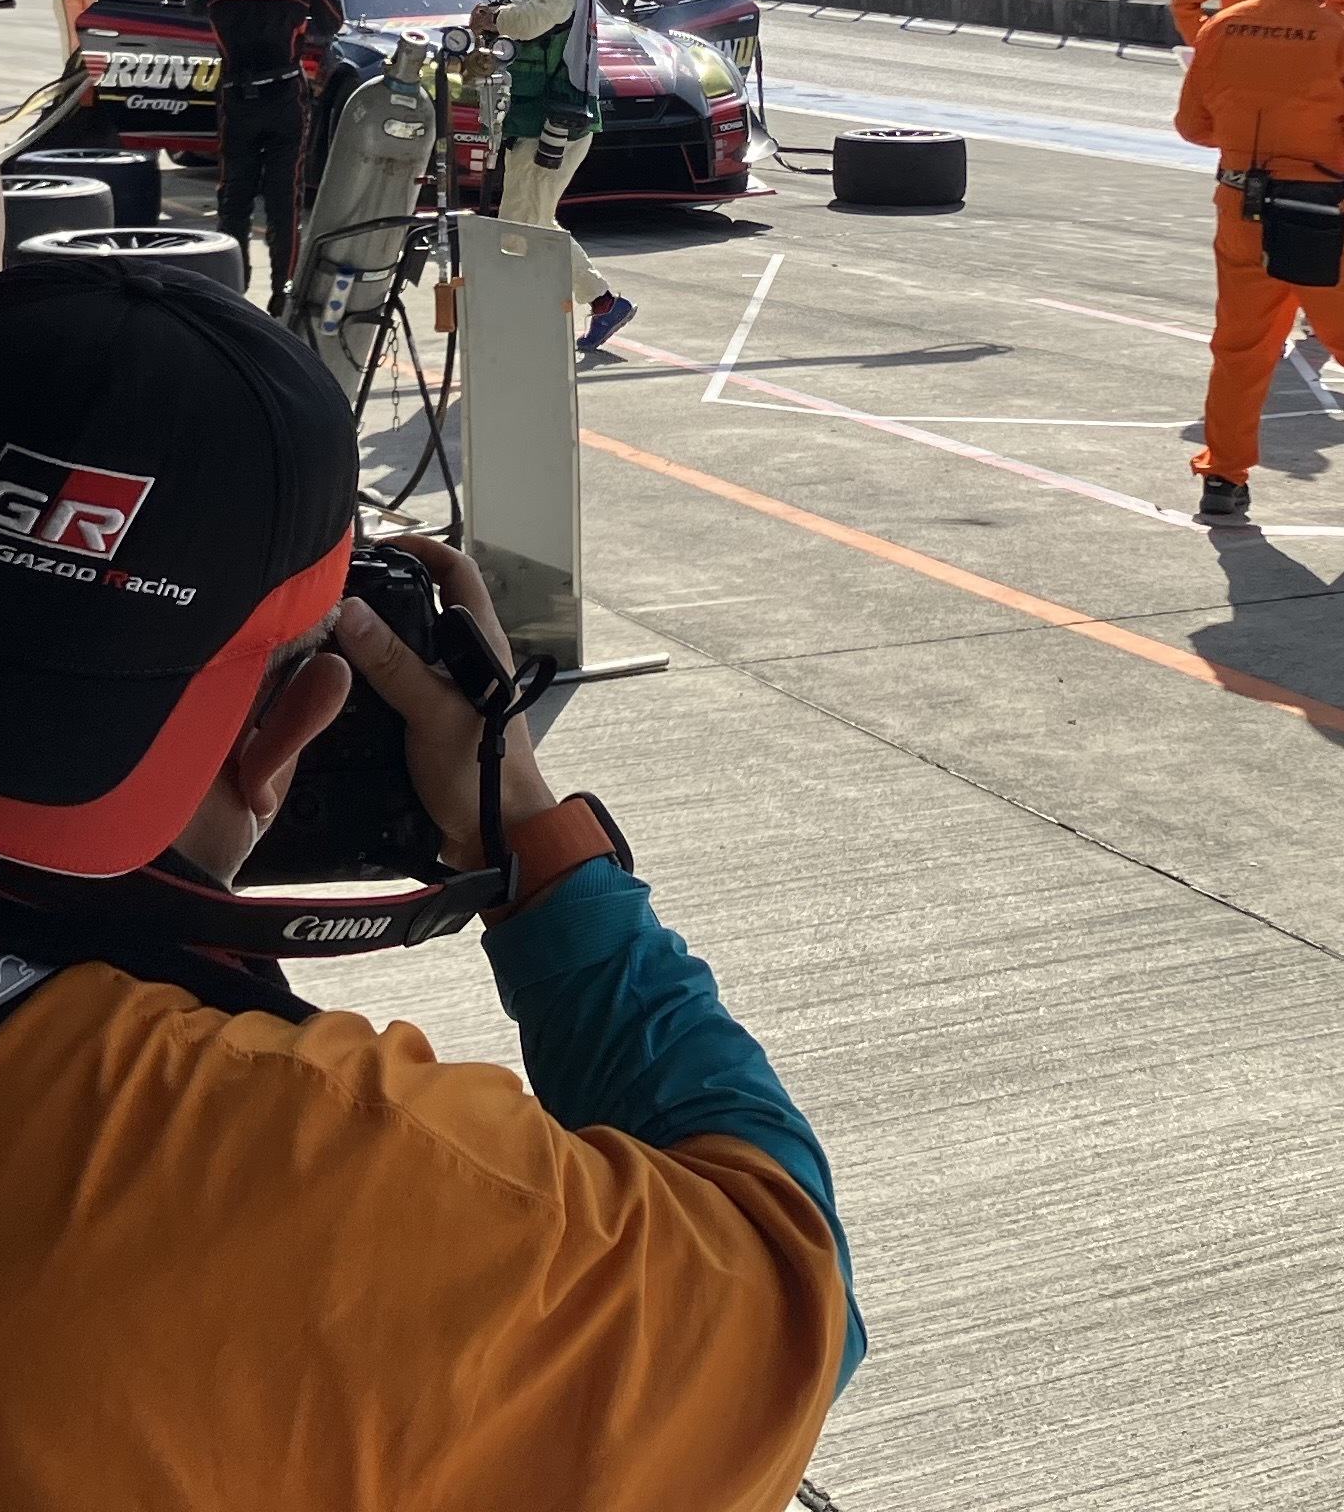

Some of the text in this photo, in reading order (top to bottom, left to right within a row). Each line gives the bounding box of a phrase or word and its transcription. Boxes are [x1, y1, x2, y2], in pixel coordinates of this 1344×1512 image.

[1224, 23, 1317, 41] OFFICIAL
[100, 51, 223, 93] RUNU
[126, 93, 189, 115] Group
[103, 570, 197, 606] Racing
[282, 915, 393, 942] Canon
